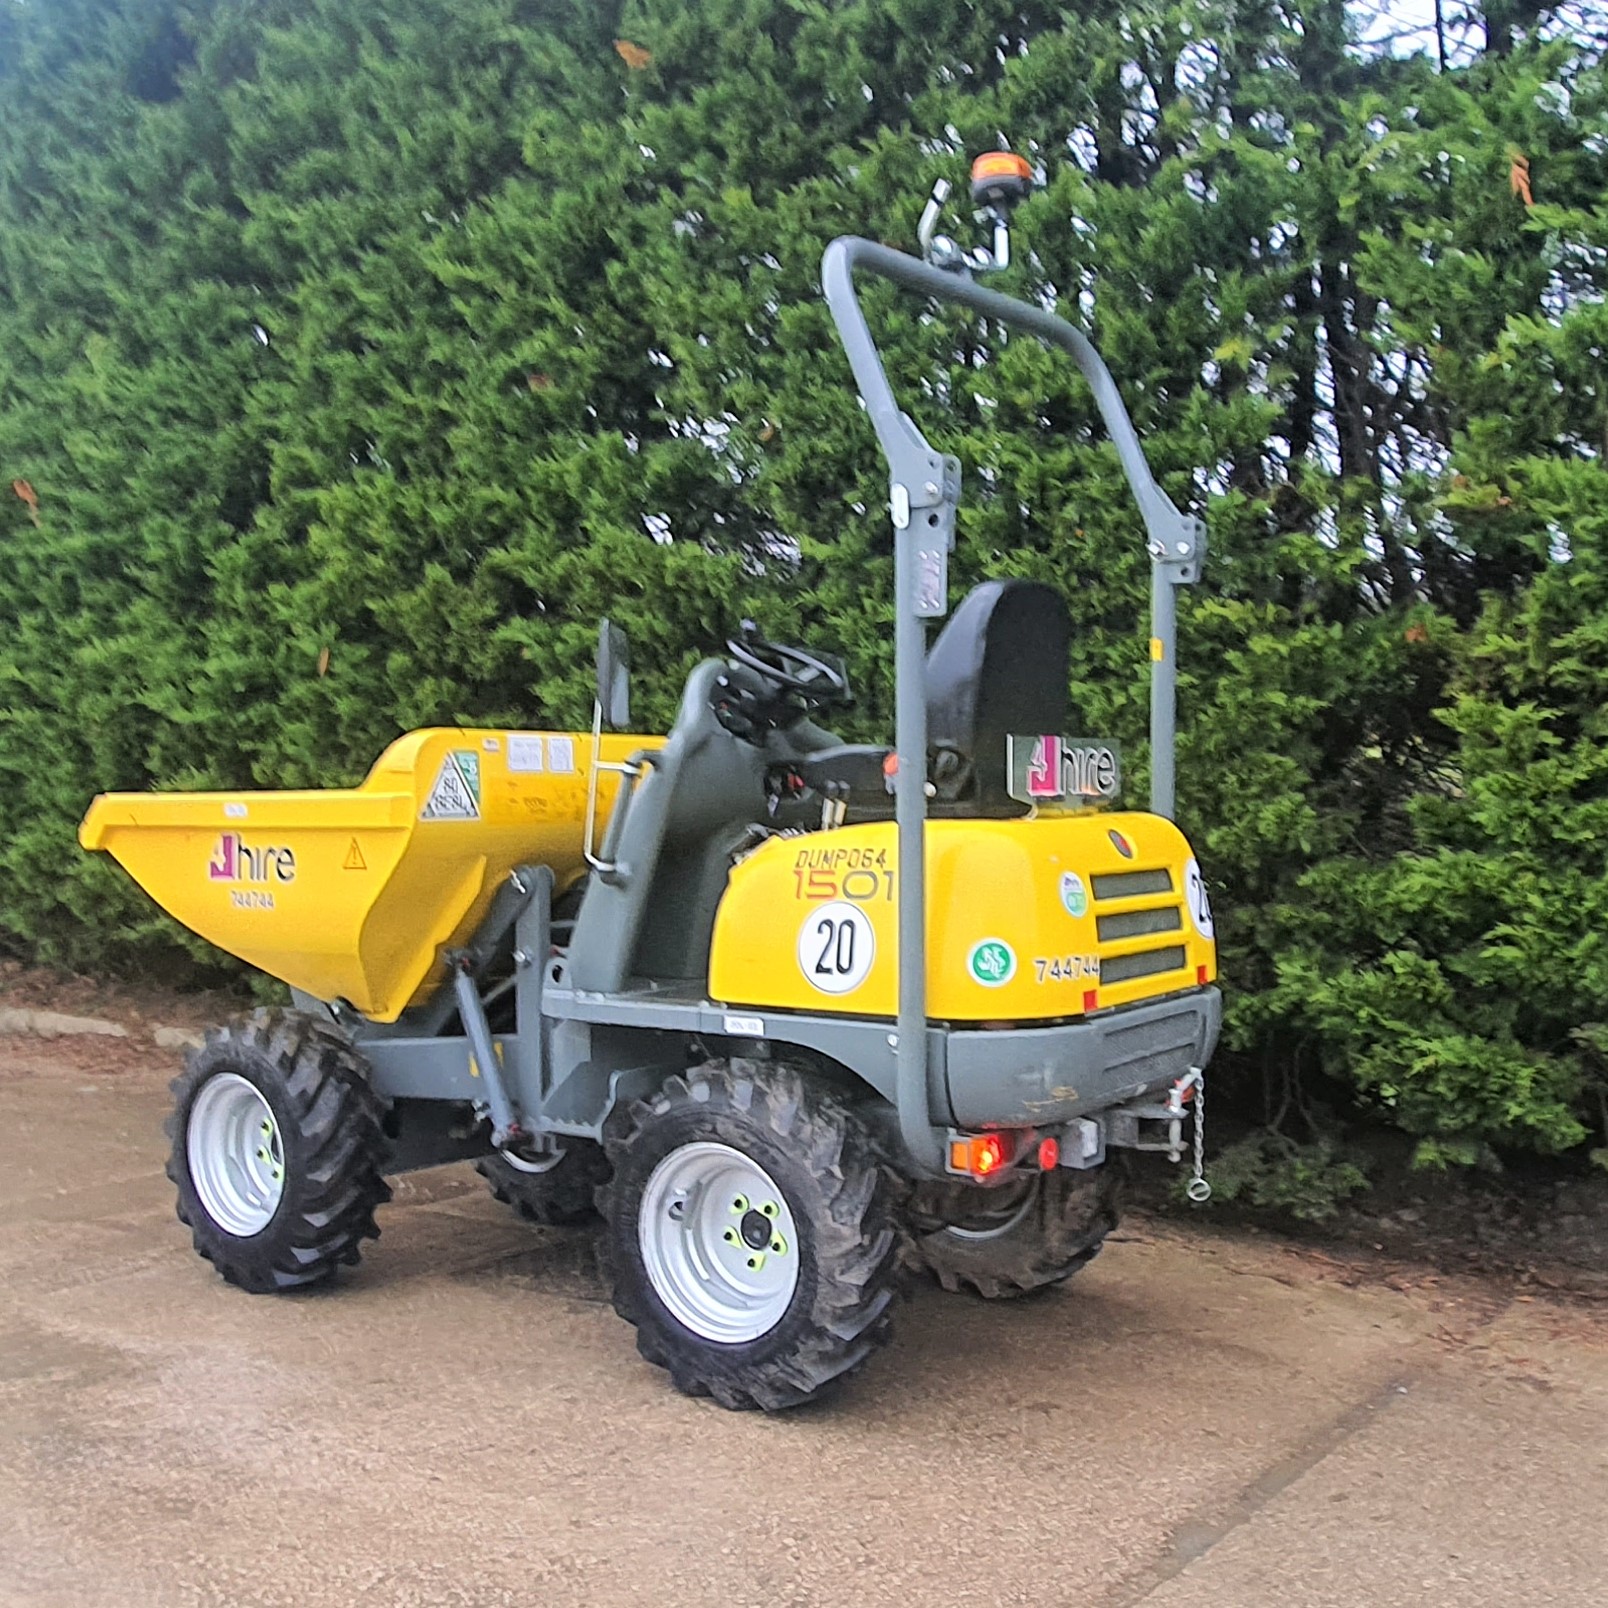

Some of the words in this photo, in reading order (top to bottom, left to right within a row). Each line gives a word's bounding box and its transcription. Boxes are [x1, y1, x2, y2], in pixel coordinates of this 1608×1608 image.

[793, 869, 895, 902] 1501
[815, 918, 857, 975] 20
[1035, 955, 1100, 982] 744744
